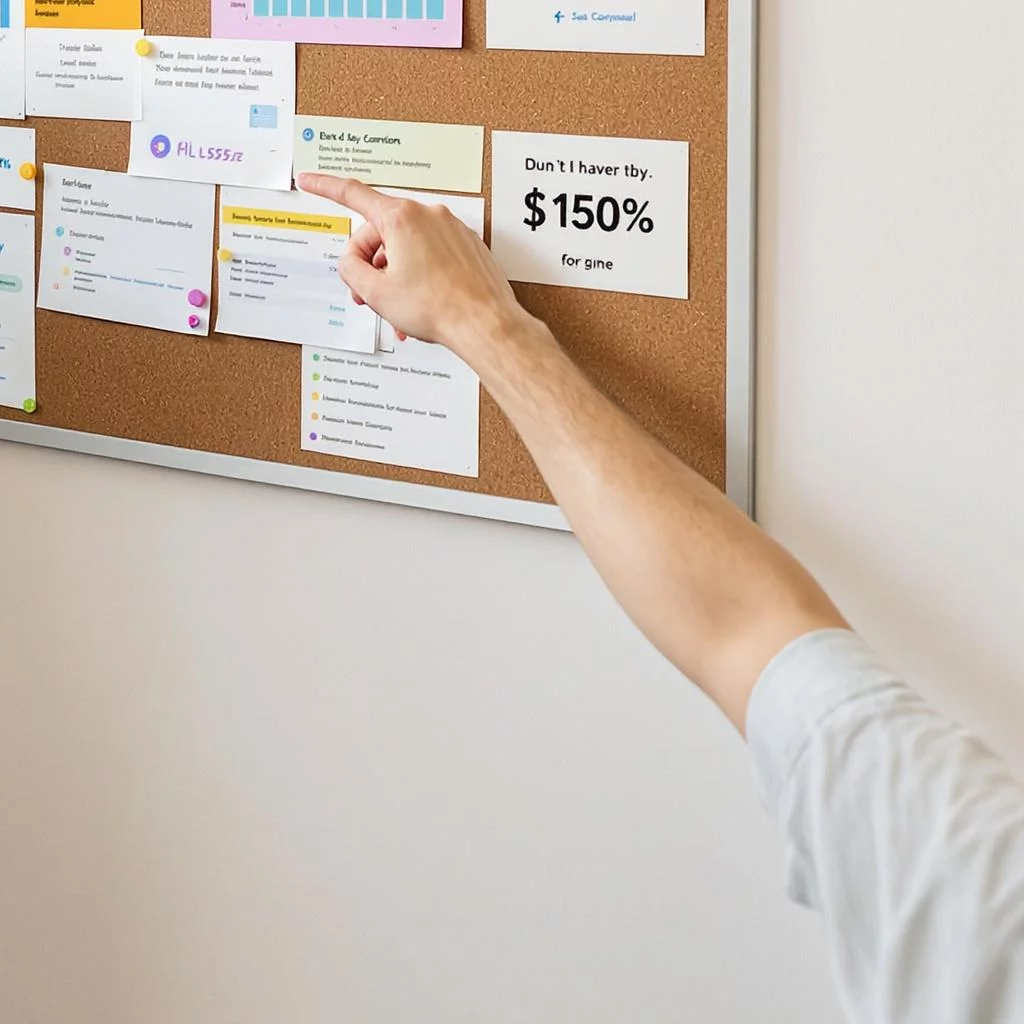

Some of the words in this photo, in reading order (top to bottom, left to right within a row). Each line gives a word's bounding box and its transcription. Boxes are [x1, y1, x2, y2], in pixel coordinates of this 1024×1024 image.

[578, 161, 619, 176] haver
[523, 187, 654, 233] $150%
[561, 254, 581, 266] for
